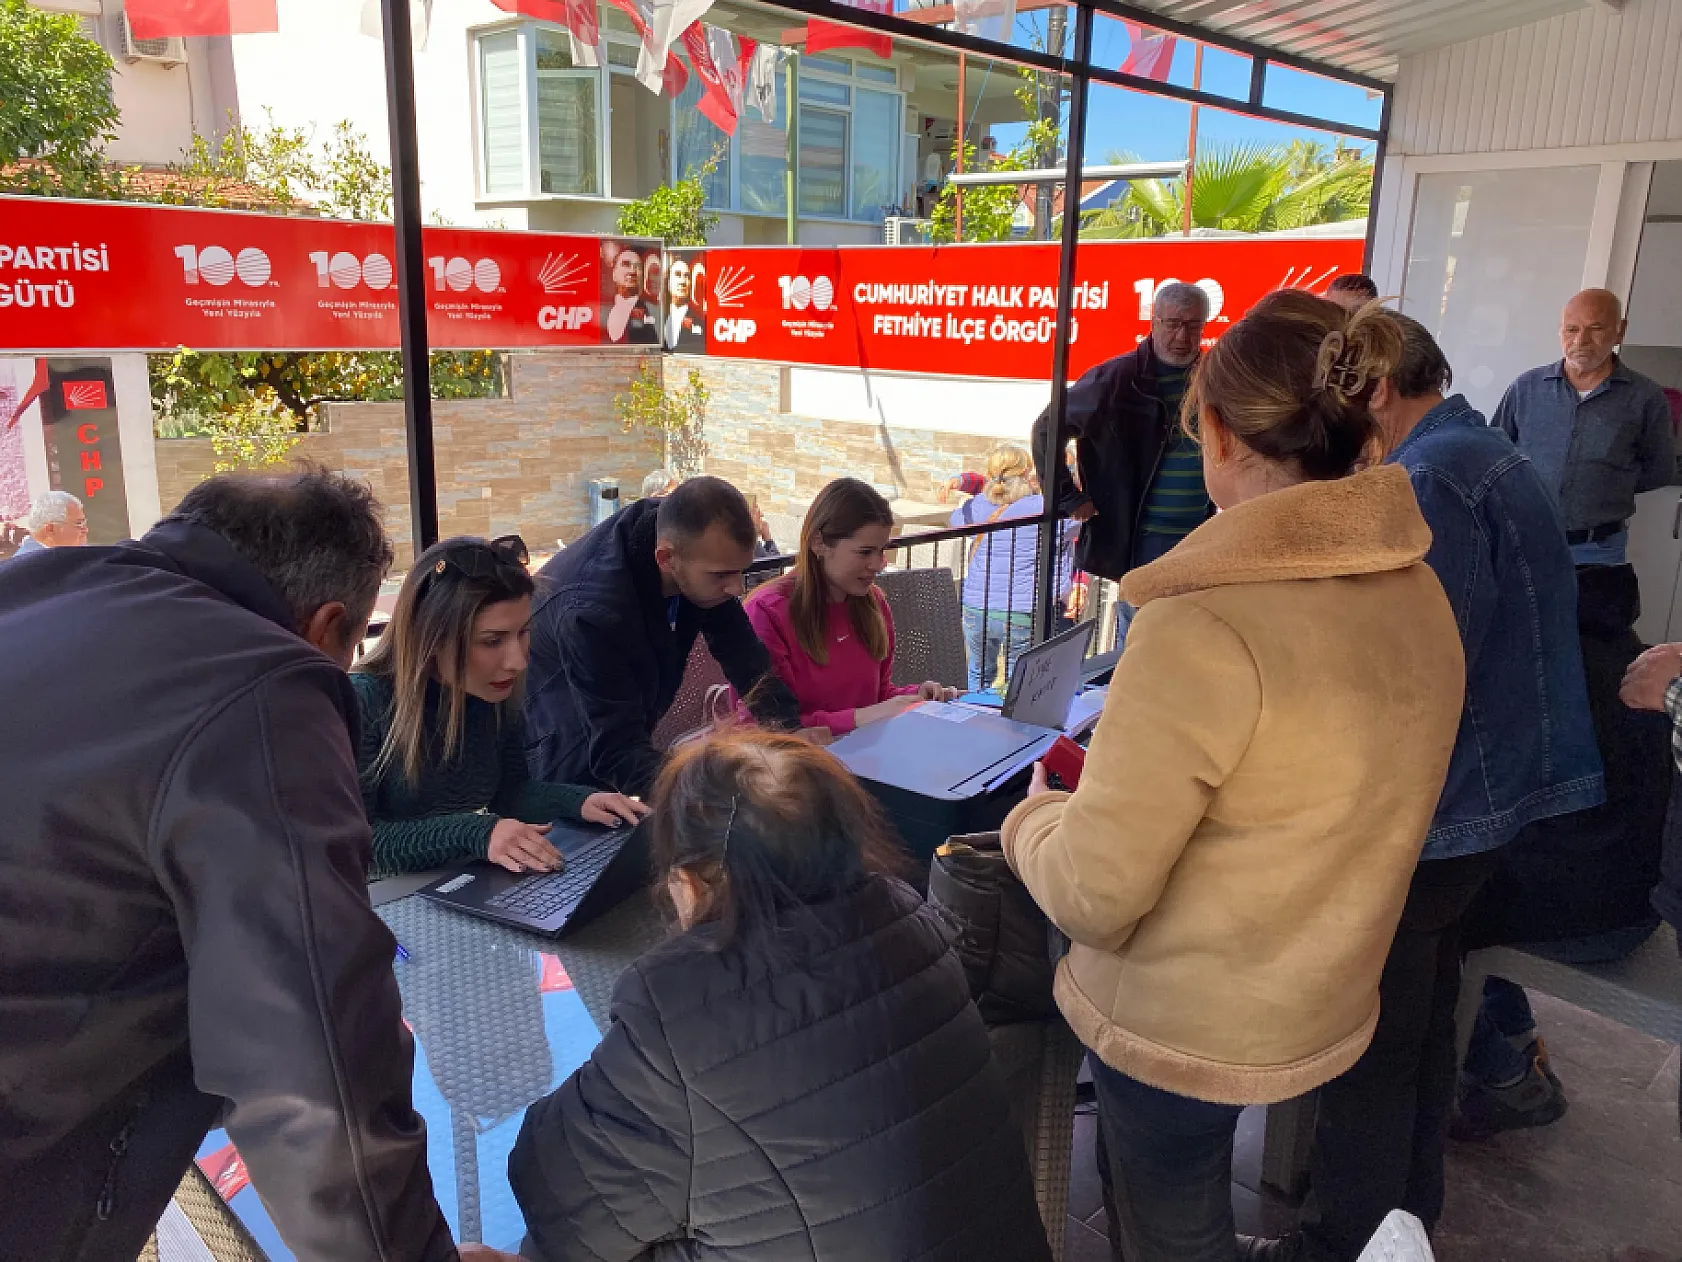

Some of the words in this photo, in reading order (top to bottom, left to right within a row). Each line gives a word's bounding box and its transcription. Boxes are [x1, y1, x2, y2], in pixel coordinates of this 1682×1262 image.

[0, 241, 109, 271] PARTİSİ
[174, 244, 271, 287] 100
[308, 251, 393, 290] 100
[428, 256, 501, 293] 100
[778, 275, 833, 311] 100
[853, 279, 969, 306] CUMHURİYET
[971, 285, 1024, 308] HALK
[1028, 280, 1109, 310] PATİSİ
[537, 306, 593, 330] CHP
[713, 317, 757, 343] CHP
[873, 311, 943, 337] FETHİYE
[946, 312, 987, 345] İLÇE
[990, 314, 1079, 344] ÖRGÜÜ
[76, 423, 104, 498] CHP
